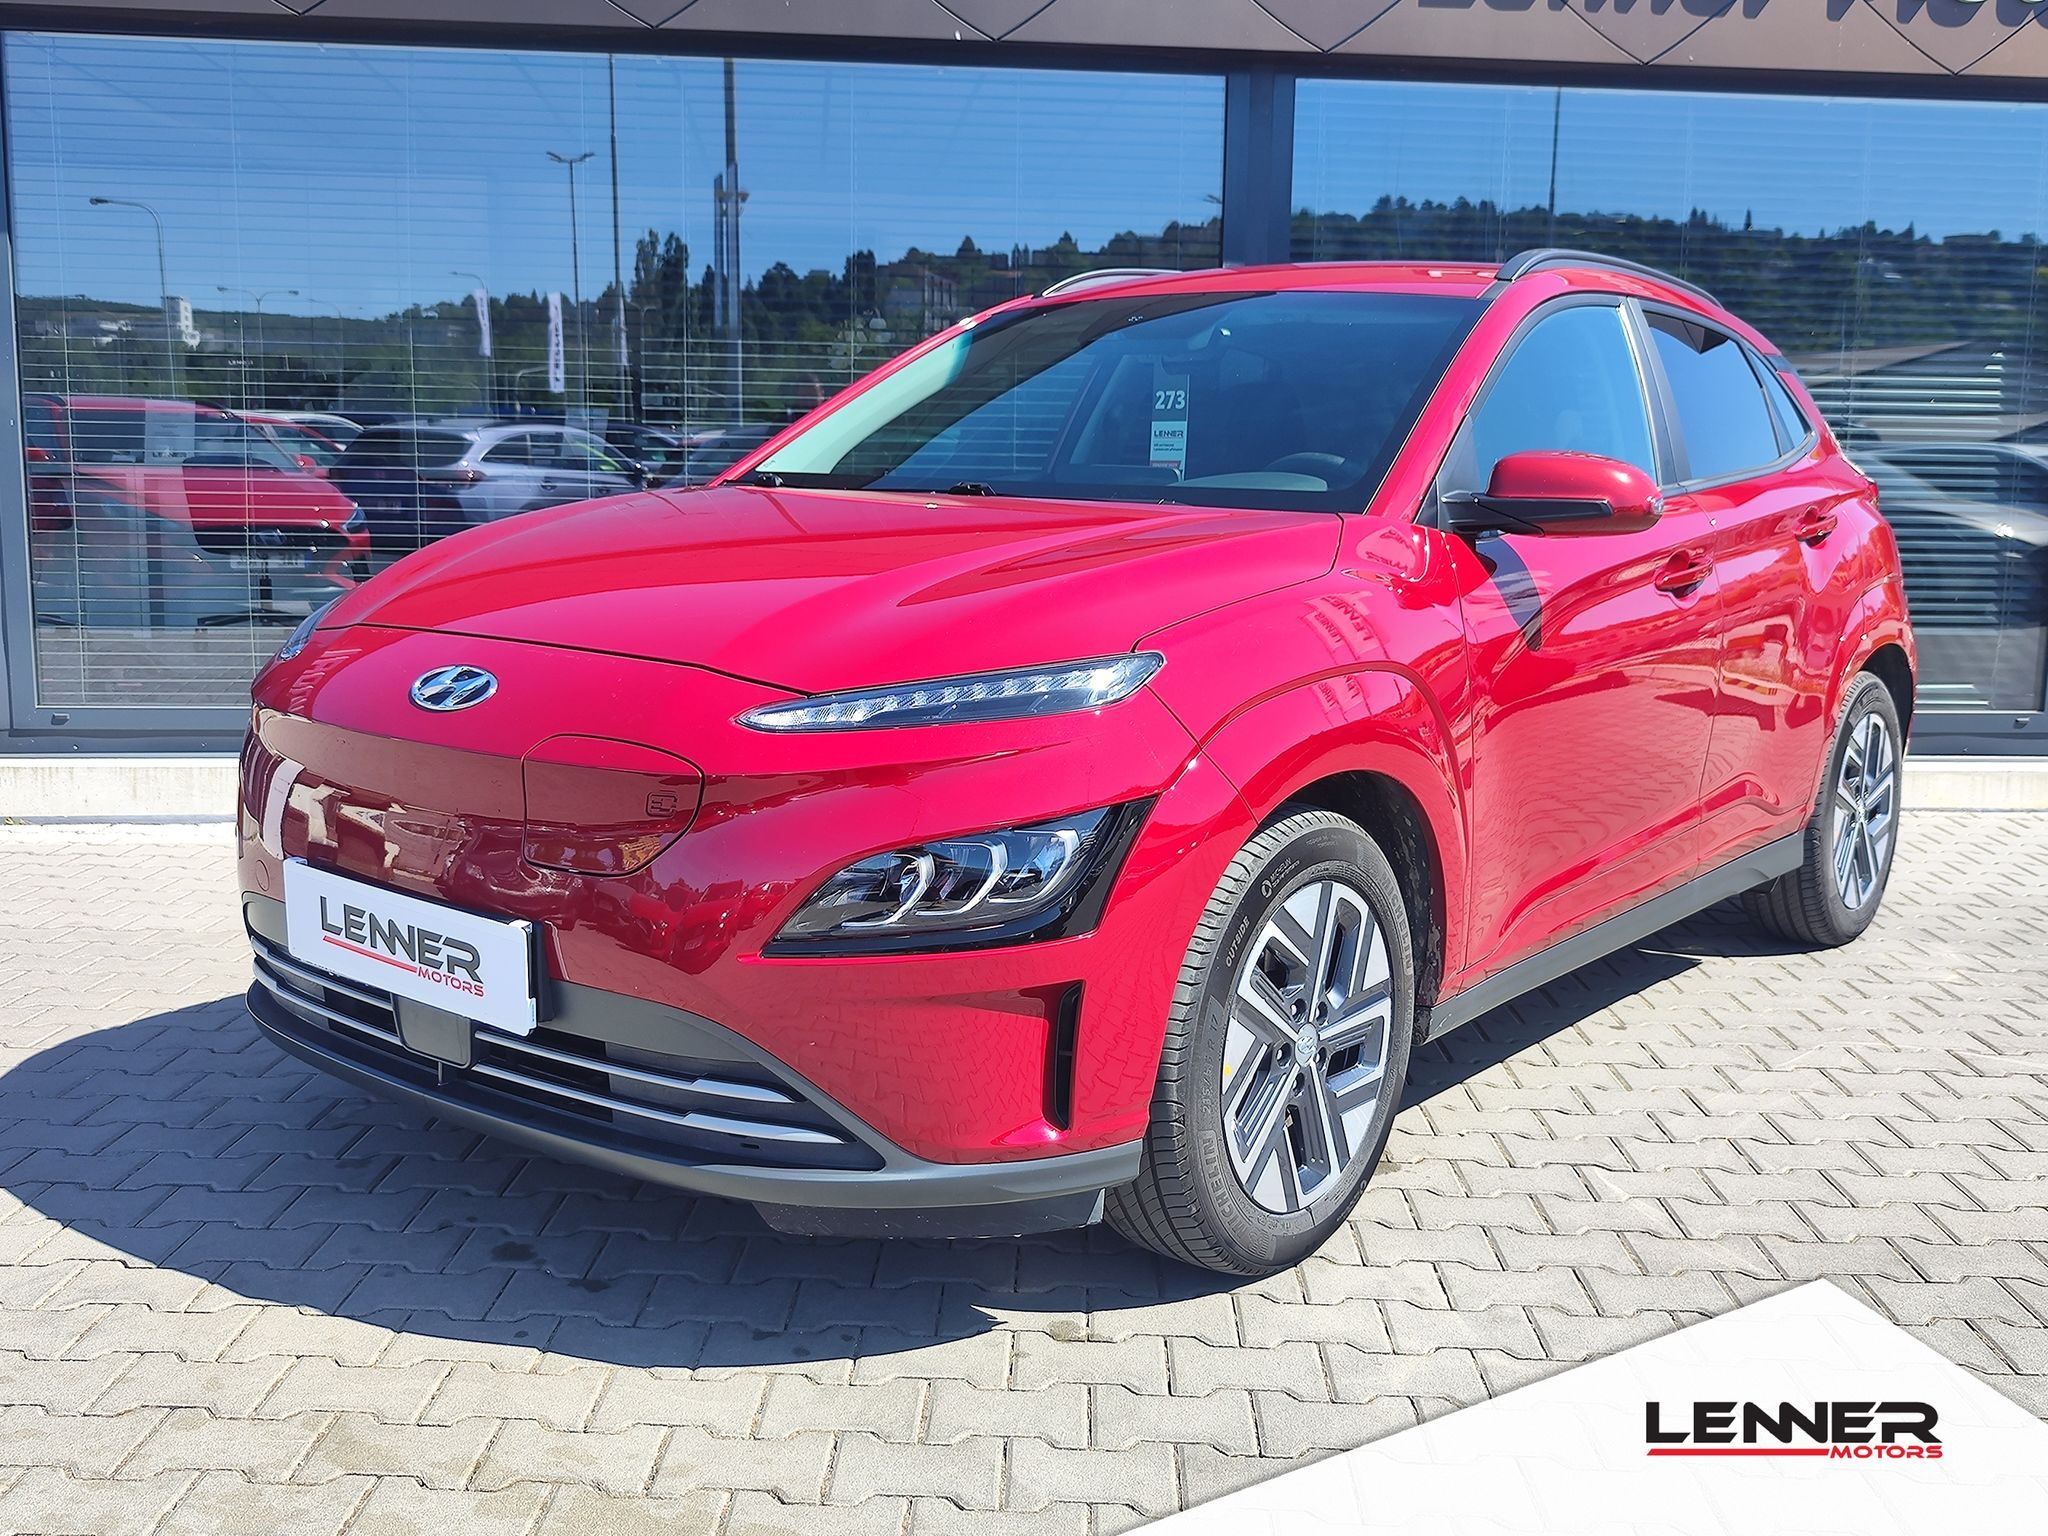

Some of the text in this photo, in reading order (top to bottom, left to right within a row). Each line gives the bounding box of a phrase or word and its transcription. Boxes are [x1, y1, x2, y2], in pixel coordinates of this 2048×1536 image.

[1155, 390, 1186, 410] 273
[319, 895, 484, 984] LENNER
[1225, 915, 1251, 968] OUTSIDE
[417, 966, 485, 998] MOTORS
